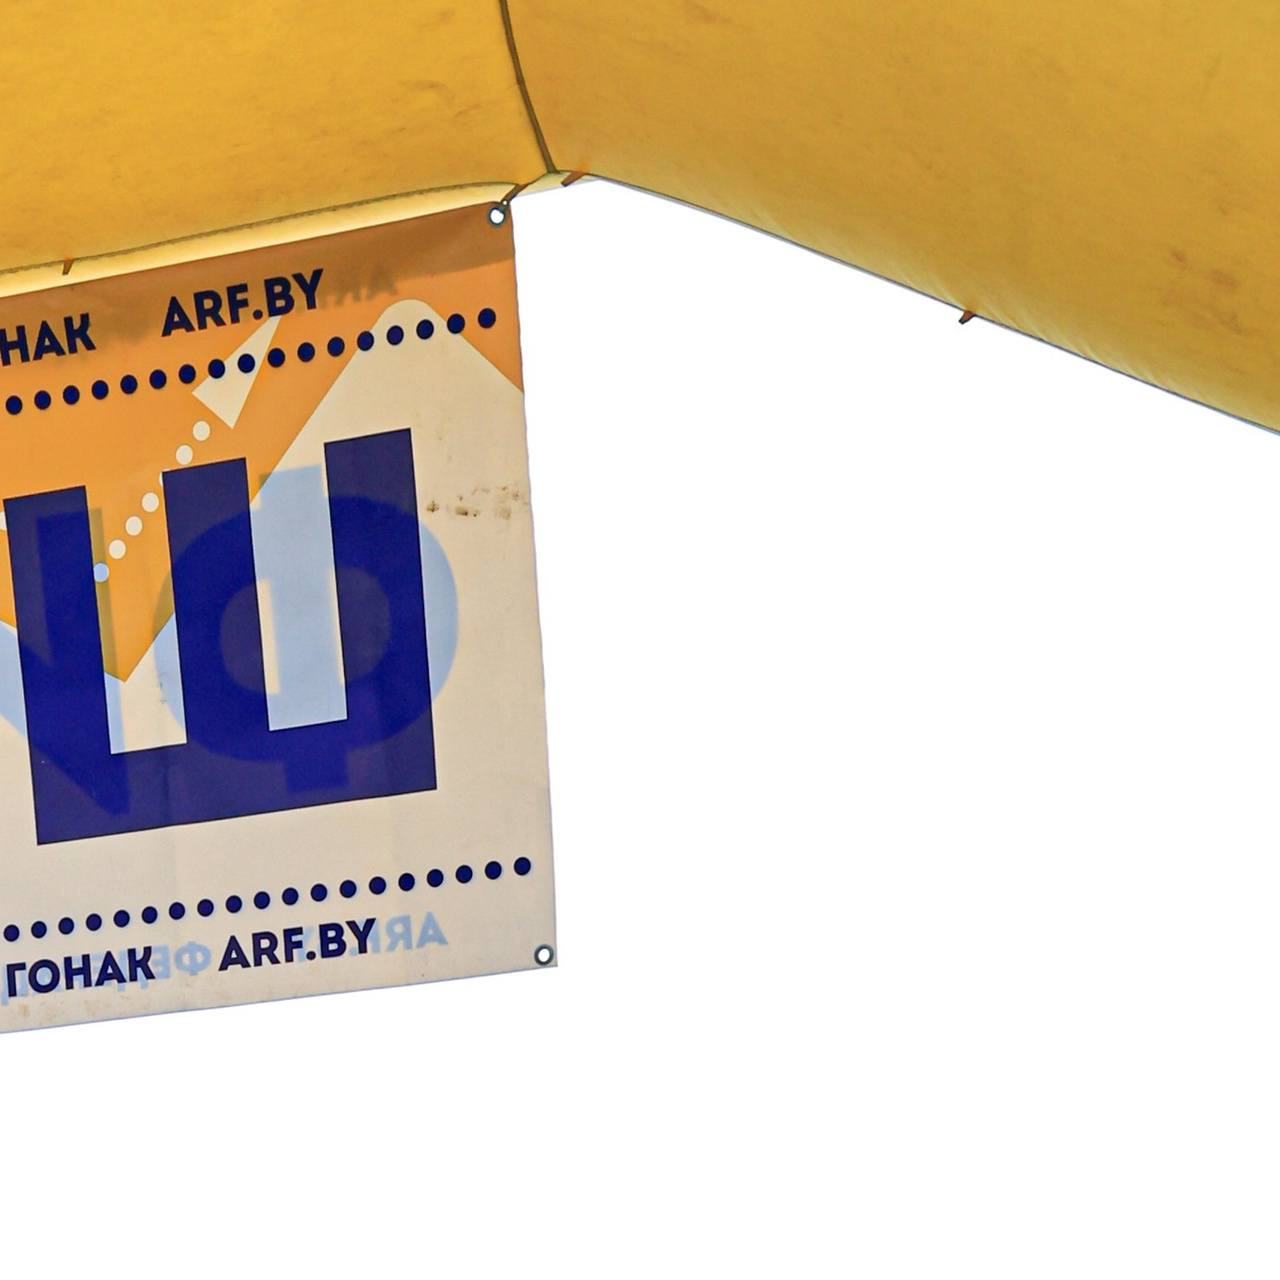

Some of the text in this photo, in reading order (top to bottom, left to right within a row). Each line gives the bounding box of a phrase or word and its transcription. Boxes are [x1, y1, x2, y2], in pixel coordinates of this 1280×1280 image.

[161, 268, 326, 338] ARF.BY
[5, 945, 156, 998] ГОНАК
[218, 917, 377, 972] ARF.BY
